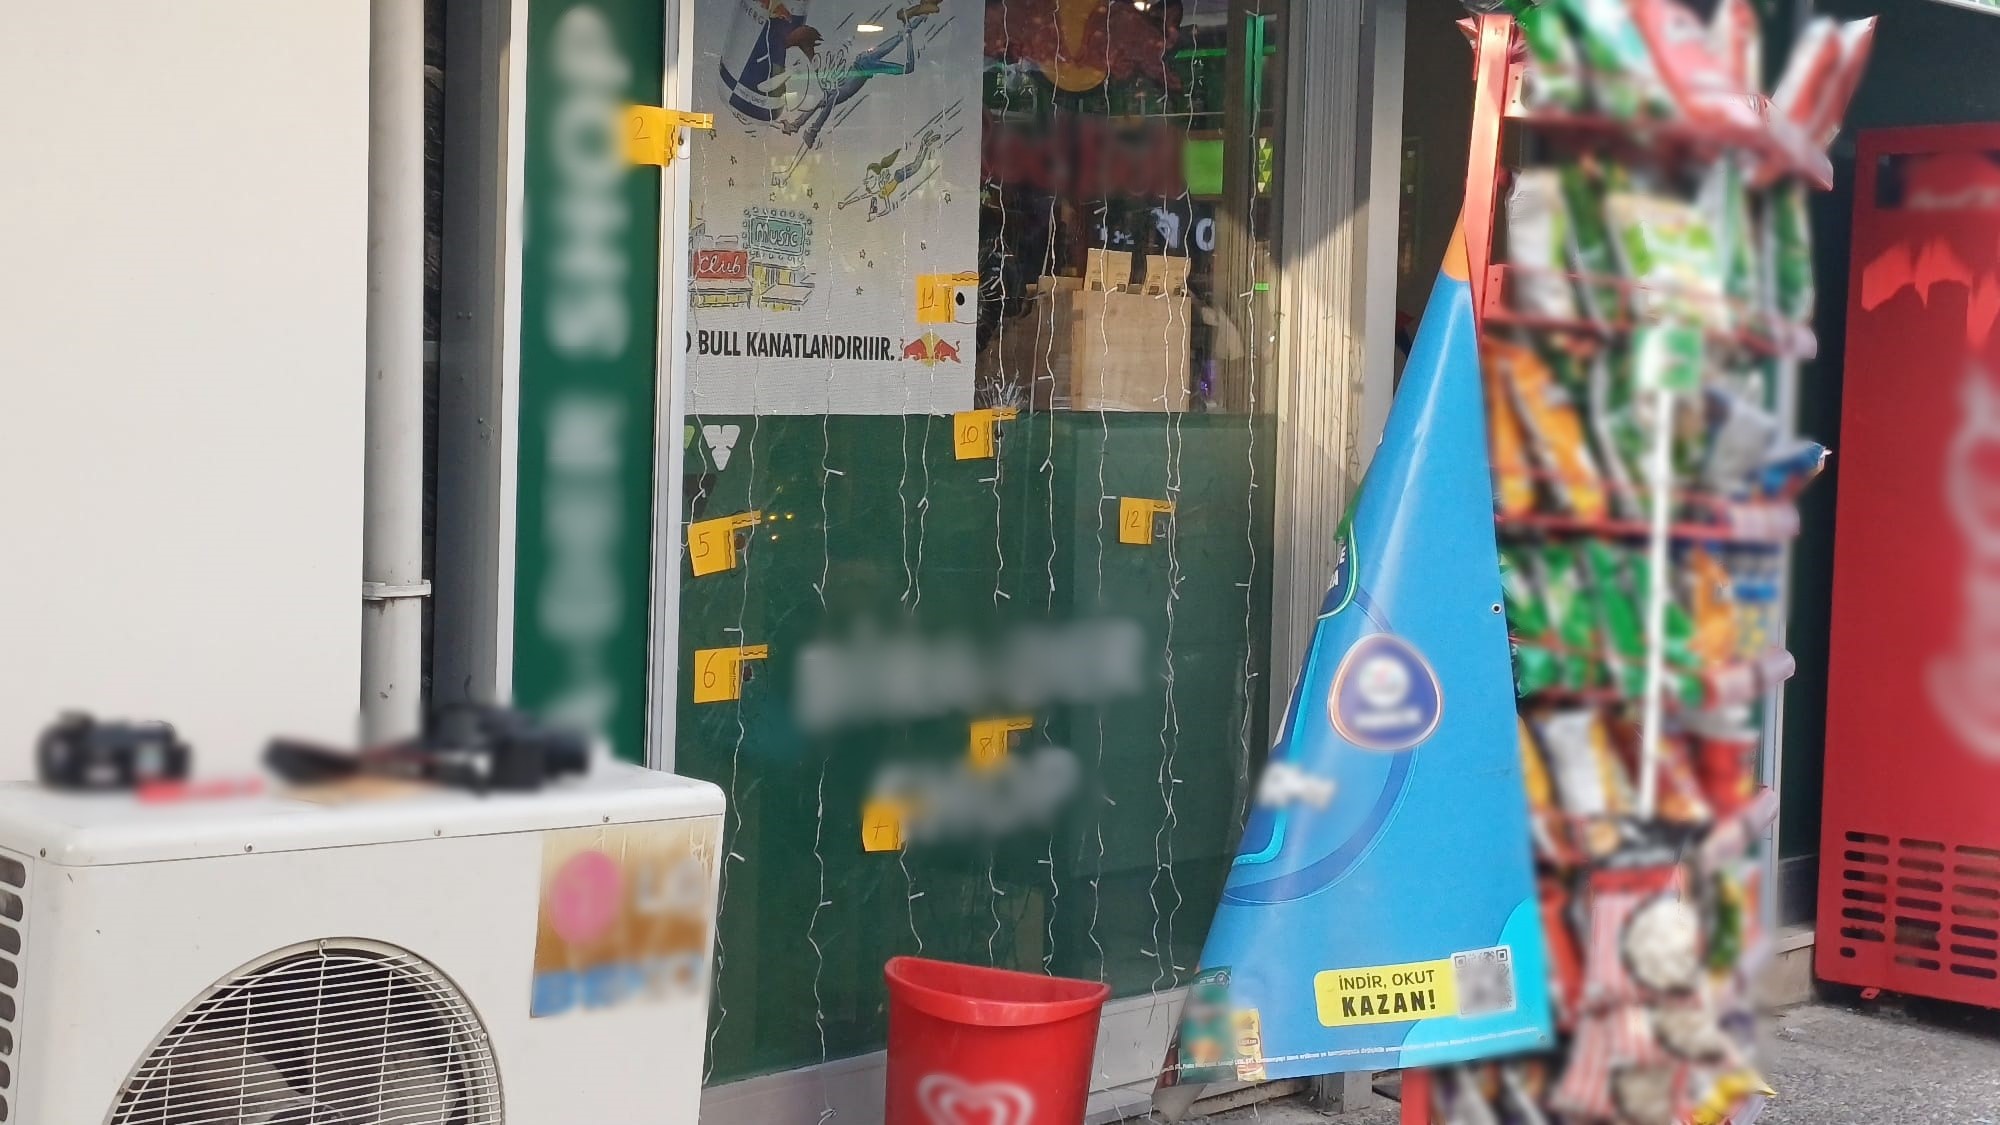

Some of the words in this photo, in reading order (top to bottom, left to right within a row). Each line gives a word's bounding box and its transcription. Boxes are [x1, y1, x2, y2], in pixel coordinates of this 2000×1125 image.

[632, 115, 651, 141] 2
[755, 222, 798, 247] Music
[698, 254, 741, 274] Club
[698, 330, 741, 357] BULL
[746, 331, 896, 361] KANATLANDIRIIIR.
[960, 424, 979, 446] 10
[1125, 510, 1141, 532] 12
[695, 531, 711, 559] 5
[703, 651, 718, 689] 6
[1338, 972, 1388, 991] İNDİR,
[1391, 969, 1436, 987] OKUT
[1341, 989, 1436, 1018] KAZAN!
